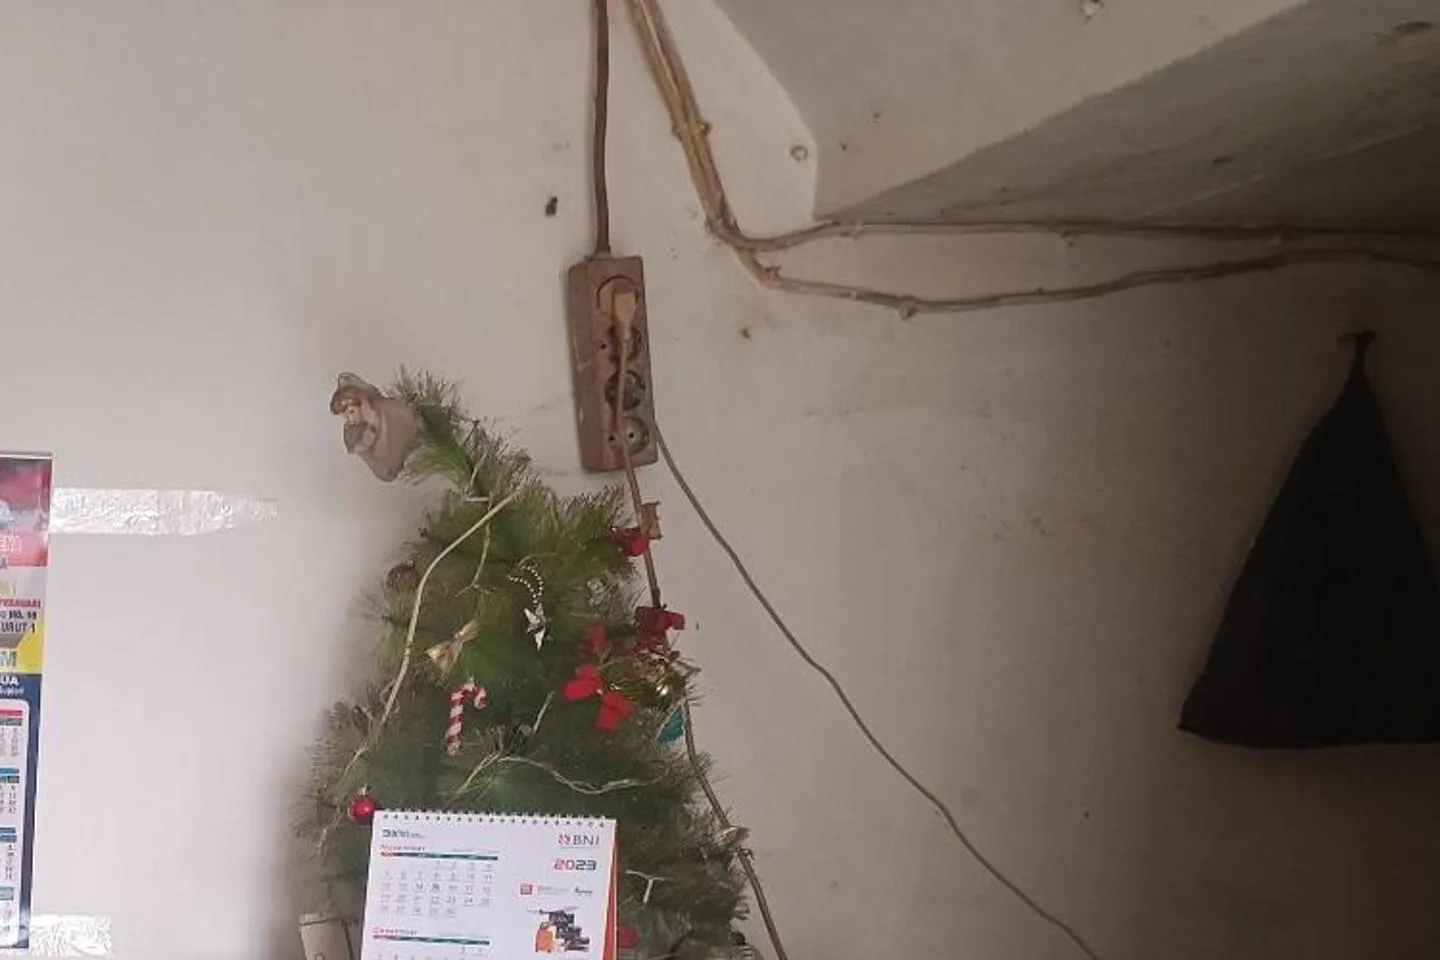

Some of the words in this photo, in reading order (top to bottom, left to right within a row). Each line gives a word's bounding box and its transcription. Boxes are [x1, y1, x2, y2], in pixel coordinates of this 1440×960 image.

[1, 621, 28, 633] URUT
[573, 834, 600, 846] BNI
[553, 859, 598, 871] 2023
